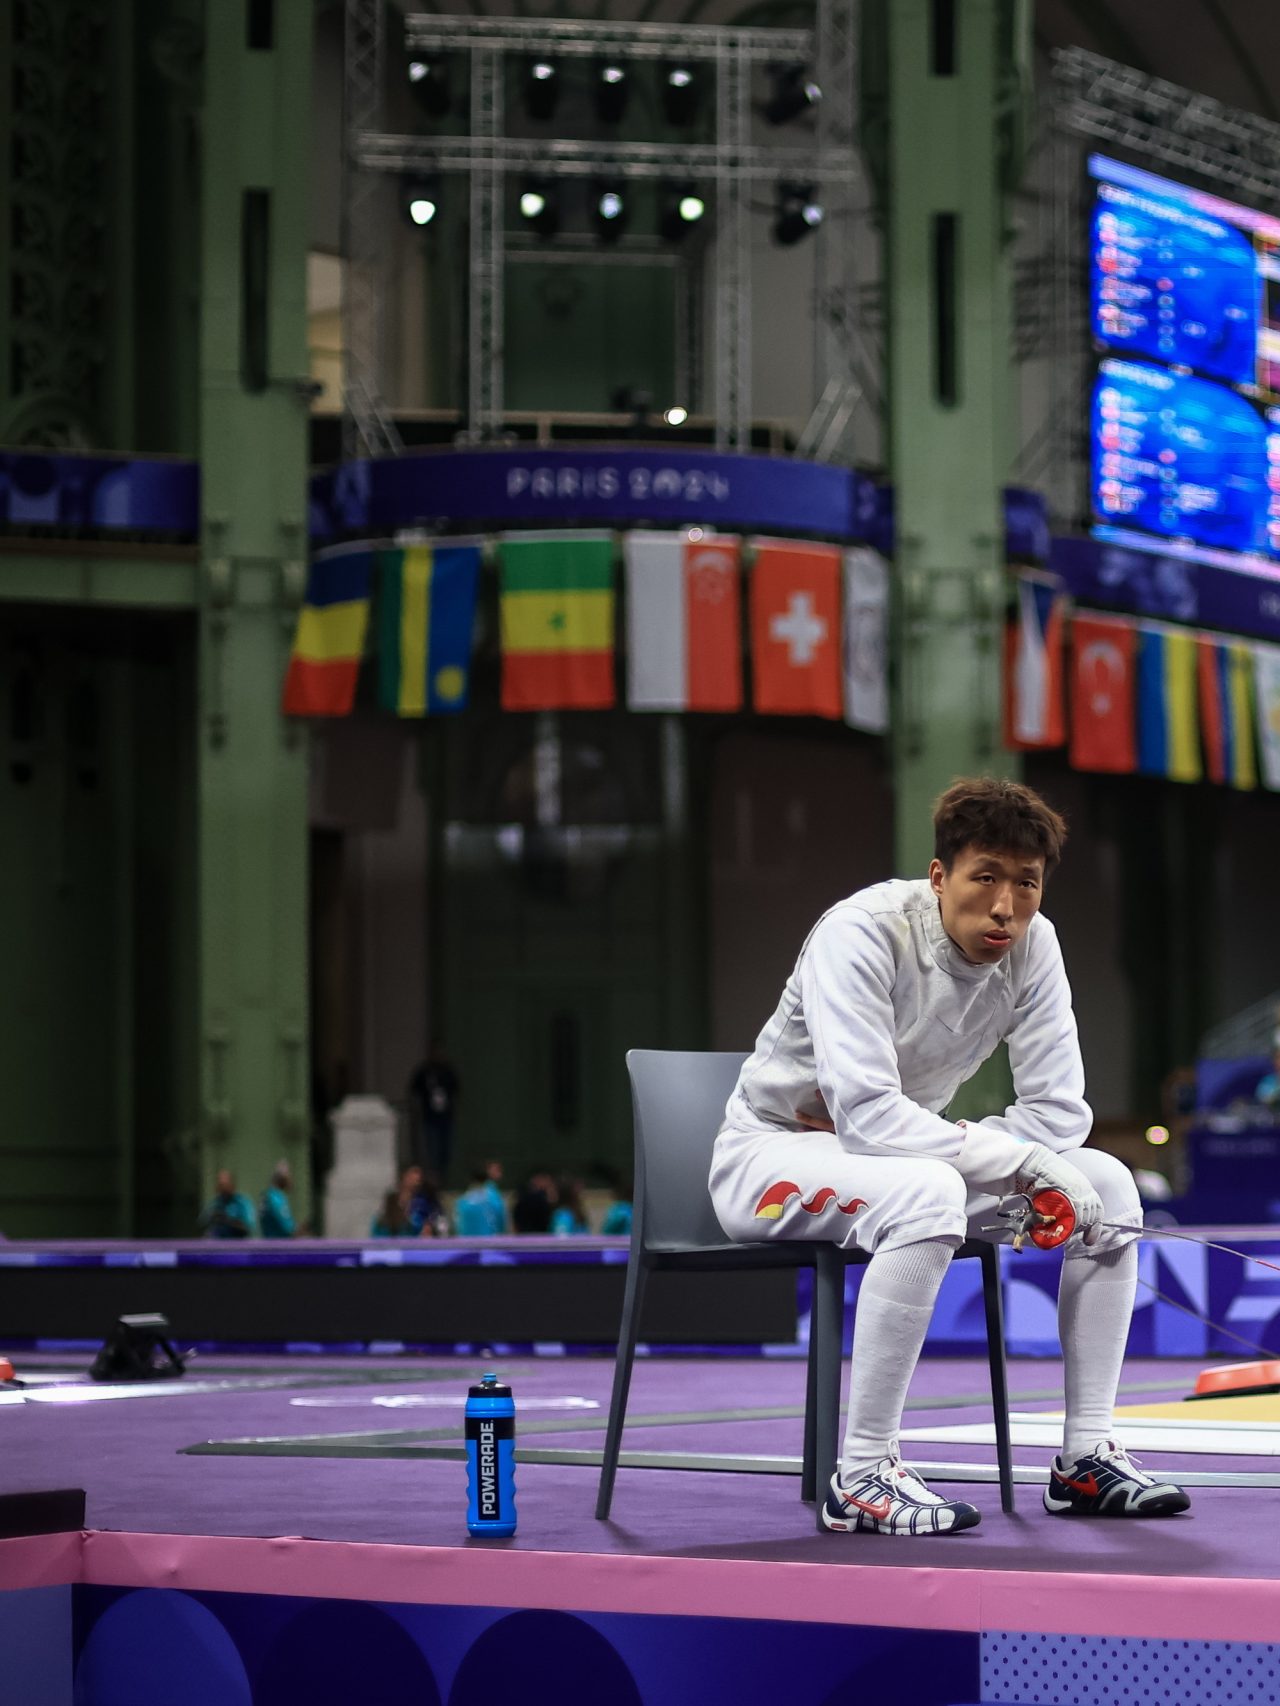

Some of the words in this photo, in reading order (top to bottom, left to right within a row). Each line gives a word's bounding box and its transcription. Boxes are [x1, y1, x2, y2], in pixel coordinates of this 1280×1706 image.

[507, 466, 620, 499] PARIS
[628, 467, 730, 501] 2024
[480, 1422, 496, 1515] POWERADE
